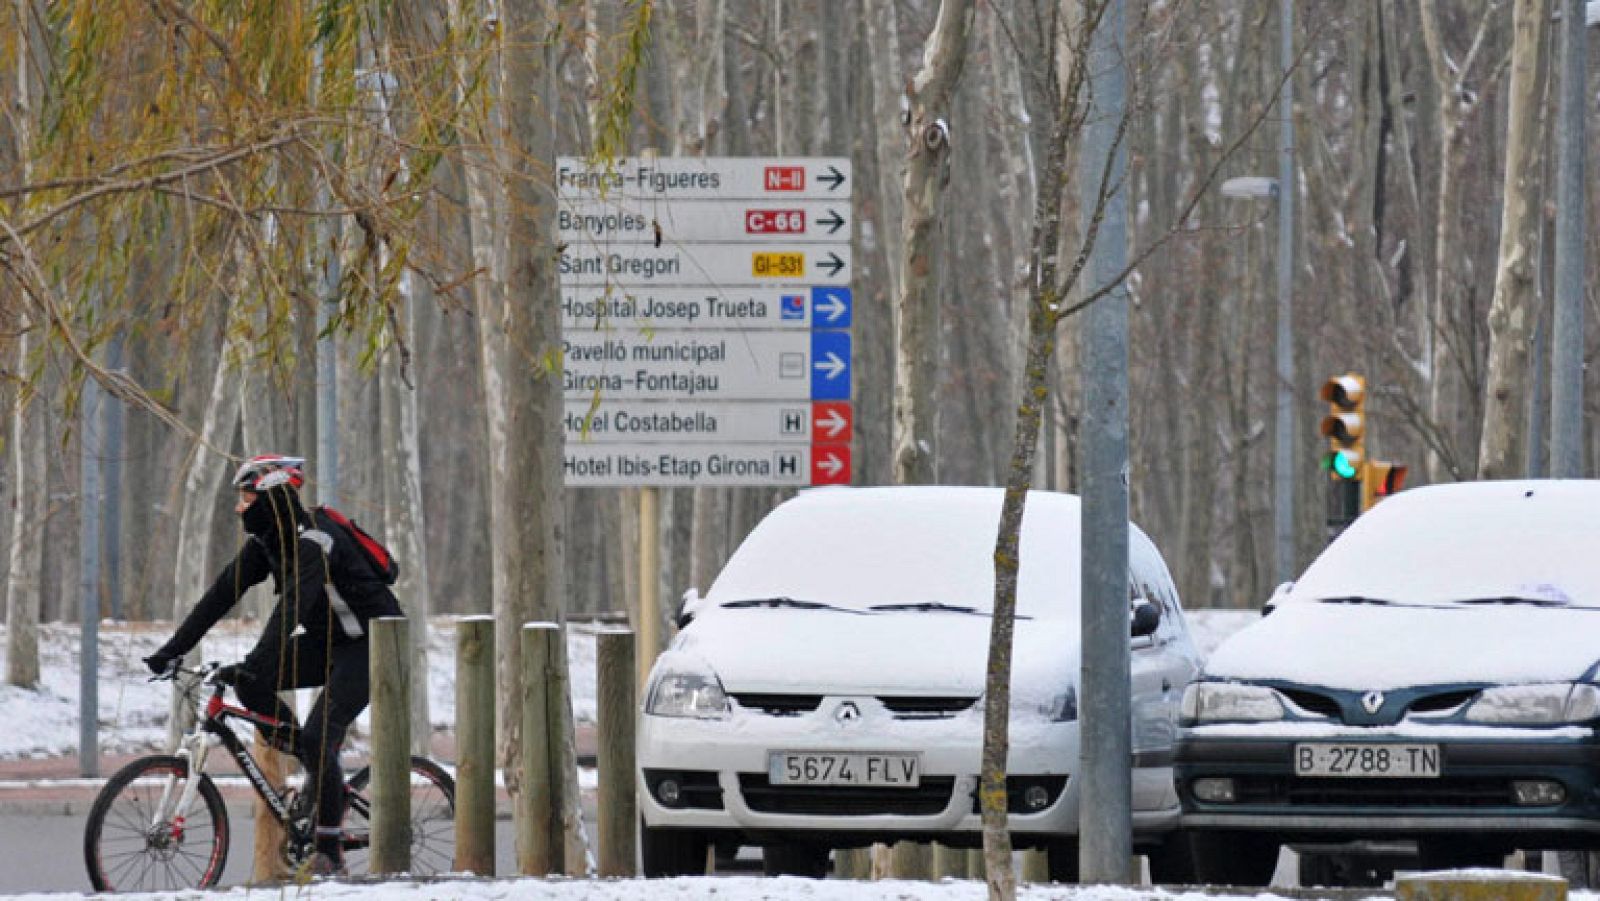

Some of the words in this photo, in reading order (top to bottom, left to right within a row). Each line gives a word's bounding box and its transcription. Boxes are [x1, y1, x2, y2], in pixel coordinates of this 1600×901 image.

[559, 210, 647, 235] Banyoles
[749, 212, 802, 231] C-66
[559, 253, 603, 274] Sant
[606, 252, 680, 278] Gregori
[754, 254, 803, 274] GI-531
[643, 296, 701, 322] Josep
[705, 297, 768, 318] Trueta
[632, 340, 726, 365] municipal
[614, 411, 718, 432] Costabella
[563, 454, 611, 475] Hotel
[618, 454, 702, 479] Ibis-Etap
[707, 454, 770, 475] Girona
[786, 756, 852, 781] 5674
[866, 758, 915, 782] FLV
